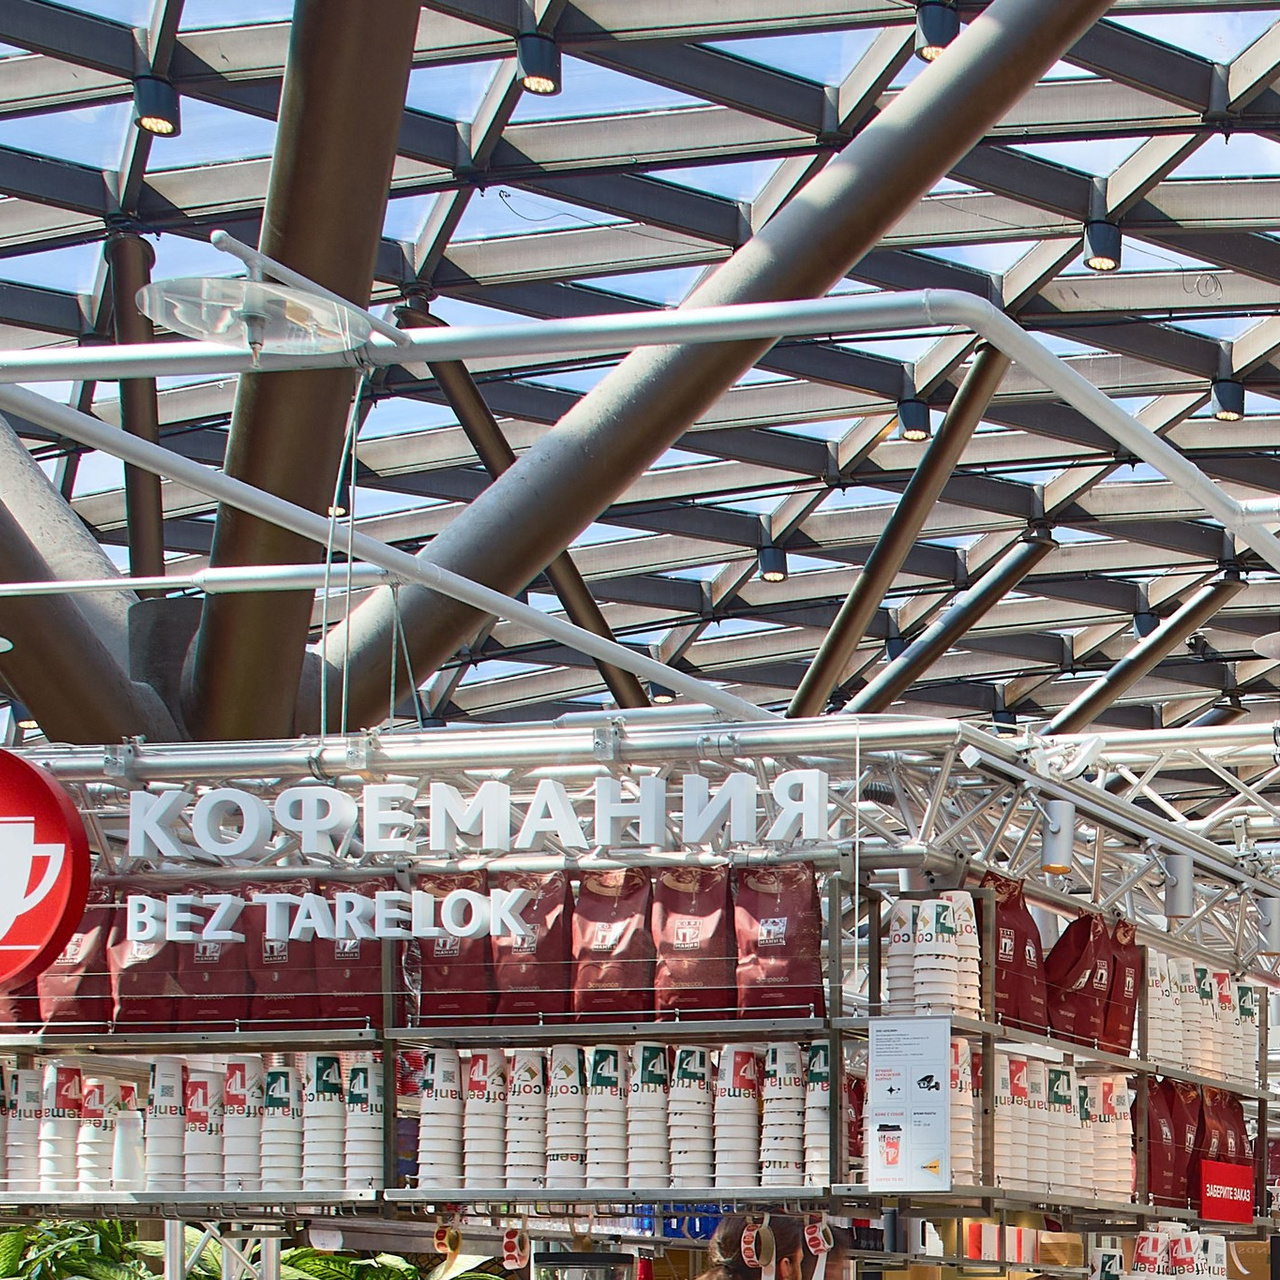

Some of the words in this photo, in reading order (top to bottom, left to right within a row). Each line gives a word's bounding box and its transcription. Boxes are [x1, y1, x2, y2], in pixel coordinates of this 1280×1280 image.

[127, 769, 829, 860] КОФЕМАНИЯ
[126, 893, 245, 943] BEZ
[253, 887, 535, 942] TARELOK
[1206, 1184, 1233, 1200] ЗАБЕРИТЕ
[1233, 1187, 1251, 1202] ЗАКАЗ
